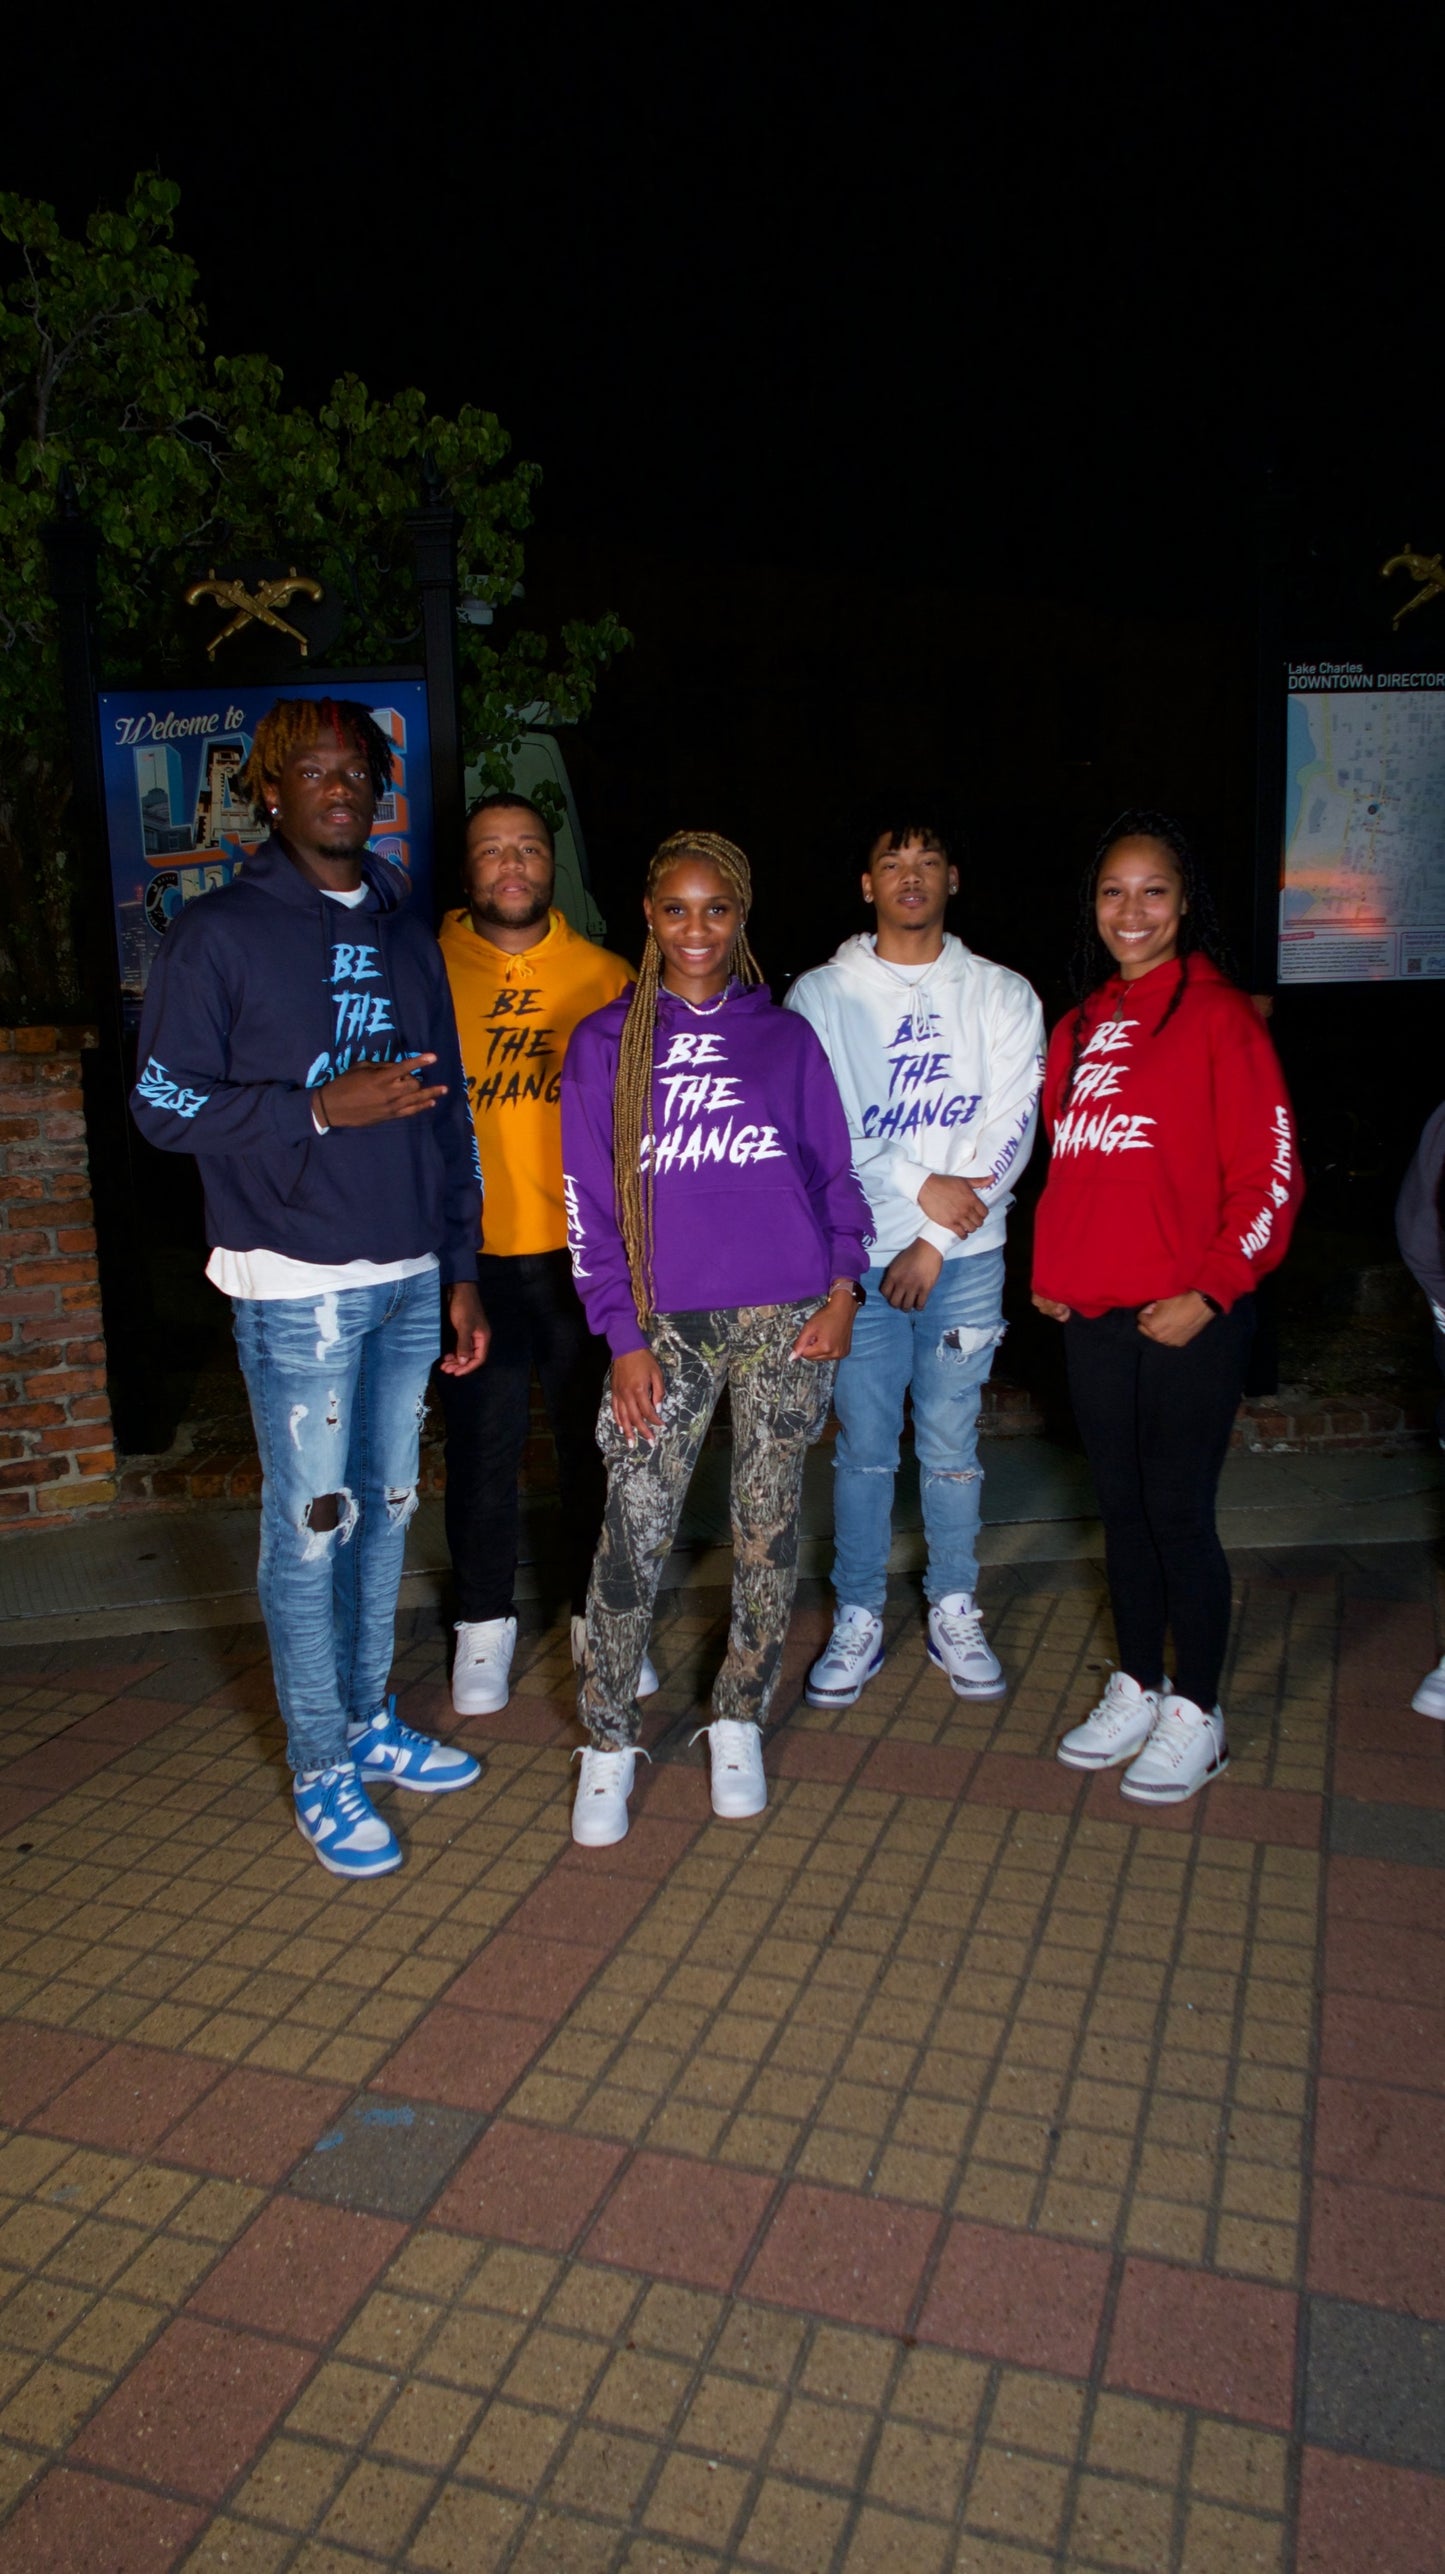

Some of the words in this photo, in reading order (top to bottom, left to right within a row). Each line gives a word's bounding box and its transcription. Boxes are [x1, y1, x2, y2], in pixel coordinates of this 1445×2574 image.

[1288, 662, 1317, 676] Lake
[1319, 661, 1364, 675] Charles
[1288, 674, 1374, 690] DOWNTOWN
[1376, 672, 1445, 689] DIRECTOR
[114, 710, 220, 746] Welcome
[223, 704, 246, 733] to
[323, 943, 384, 985] BE
[332, 989, 396, 1048] THE
[480, 989, 546, 1019] BE
[486, 1027, 556, 1068] THE
[653, 1032, 729, 1070] BE
[882, 1014, 945, 1049] BE
[1079, 1020, 1141, 1058] BE
[467, 1068, 562, 1114] CHANG
[888, 1052, 954, 1101] THE
[1070, 1061, 1131, 1107] THE
[658, 1072, 746, 1128] THE
[861, 1089, 984, 1141] CHANGE
[1052, 1104, 1158, 1160] HANGE
[1263, 1179, 1290, 1210] BY
